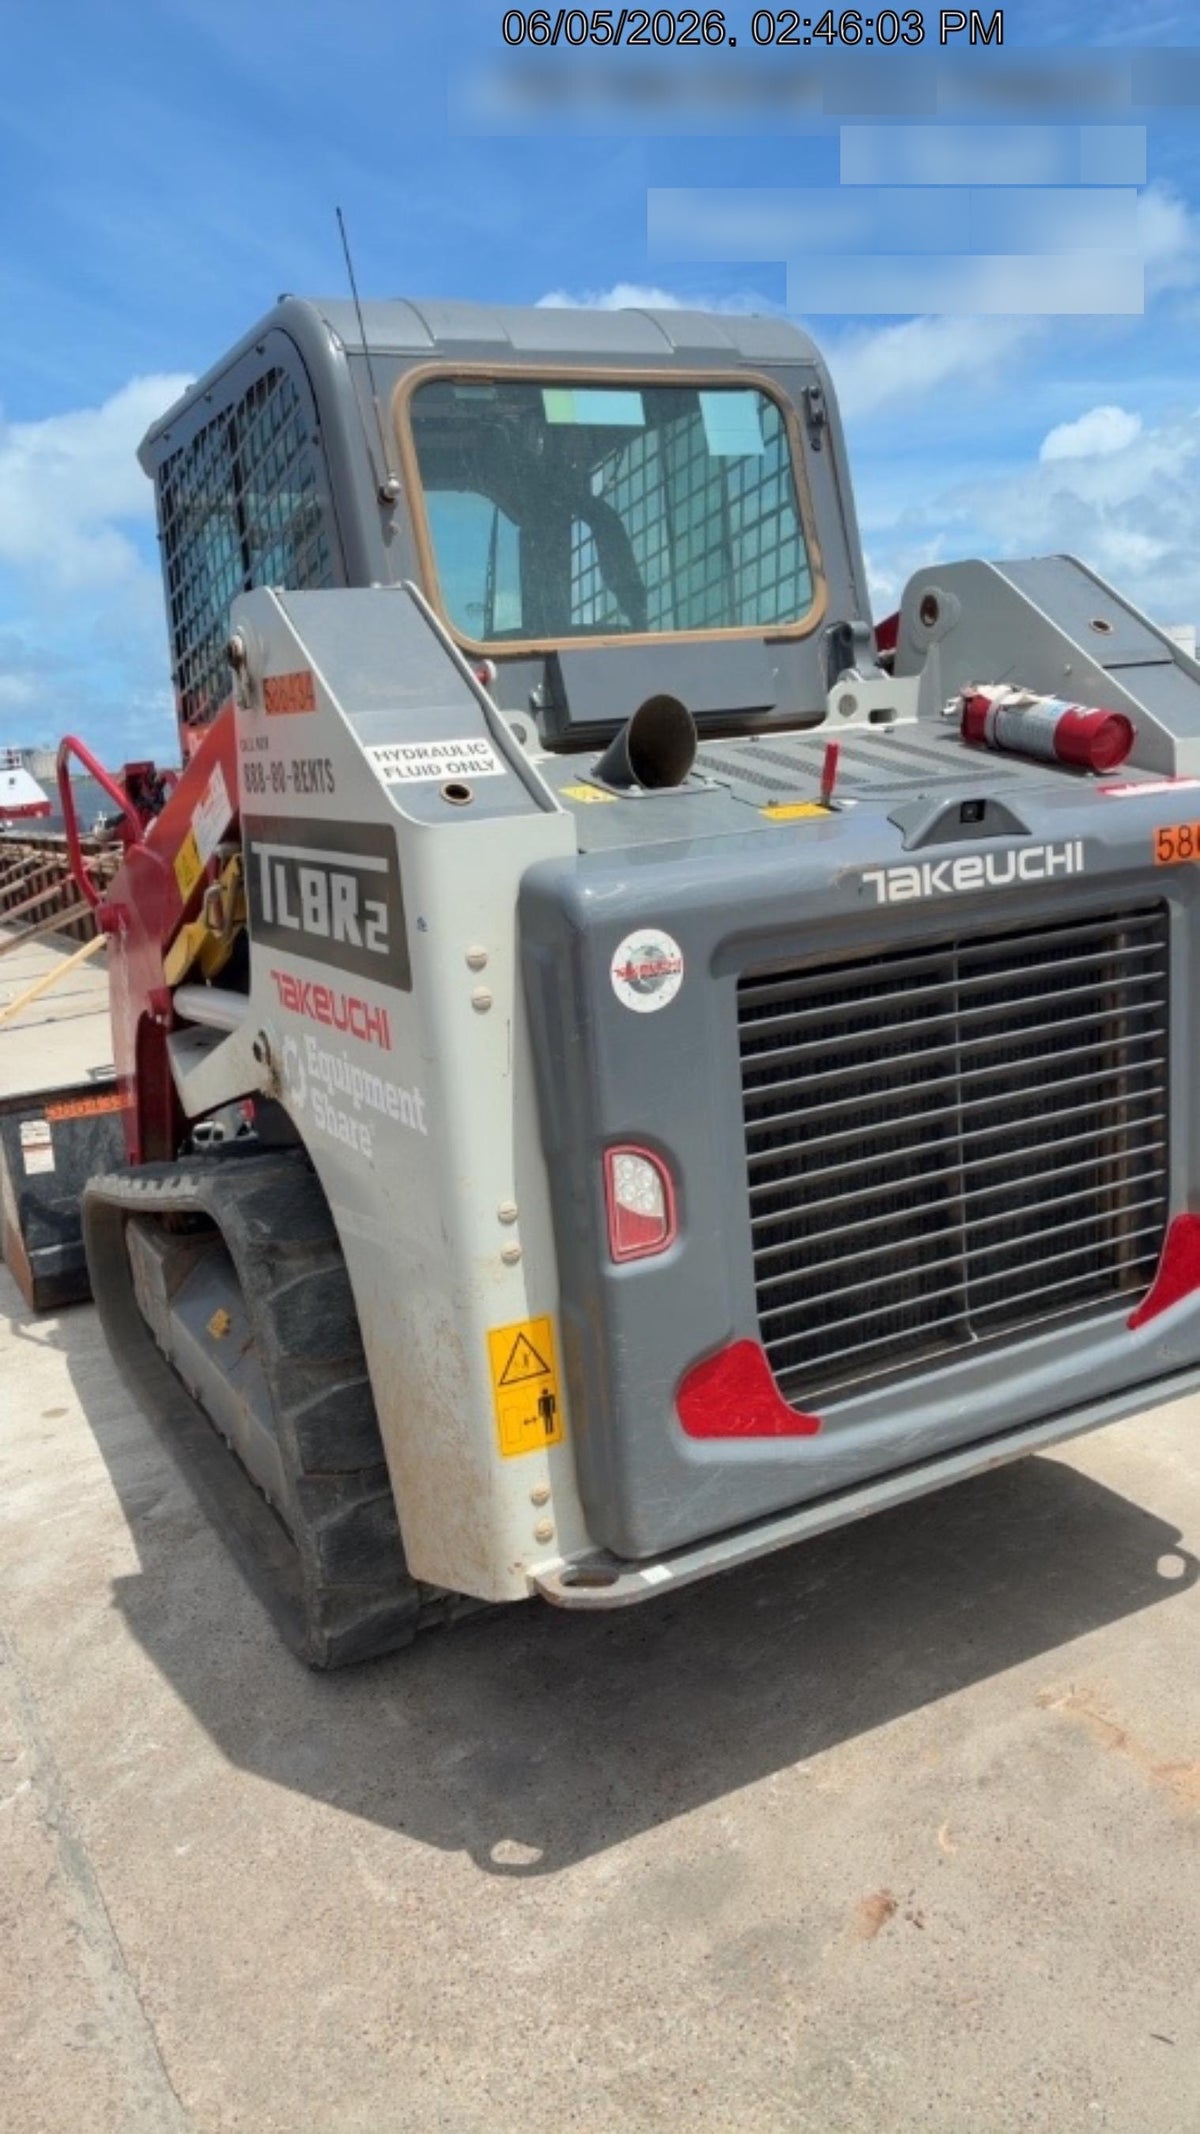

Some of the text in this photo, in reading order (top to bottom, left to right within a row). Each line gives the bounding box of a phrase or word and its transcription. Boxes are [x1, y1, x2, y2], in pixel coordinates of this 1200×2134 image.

[373, 741, 488, 762] HYDRAULIC
[384, 759, 495, 778] FLUID ONLY
[1157, 824, 1200, 862] 58
[303, 1033, 428, 1136] Equipment
[312, 1087, 373, 1157] Share
